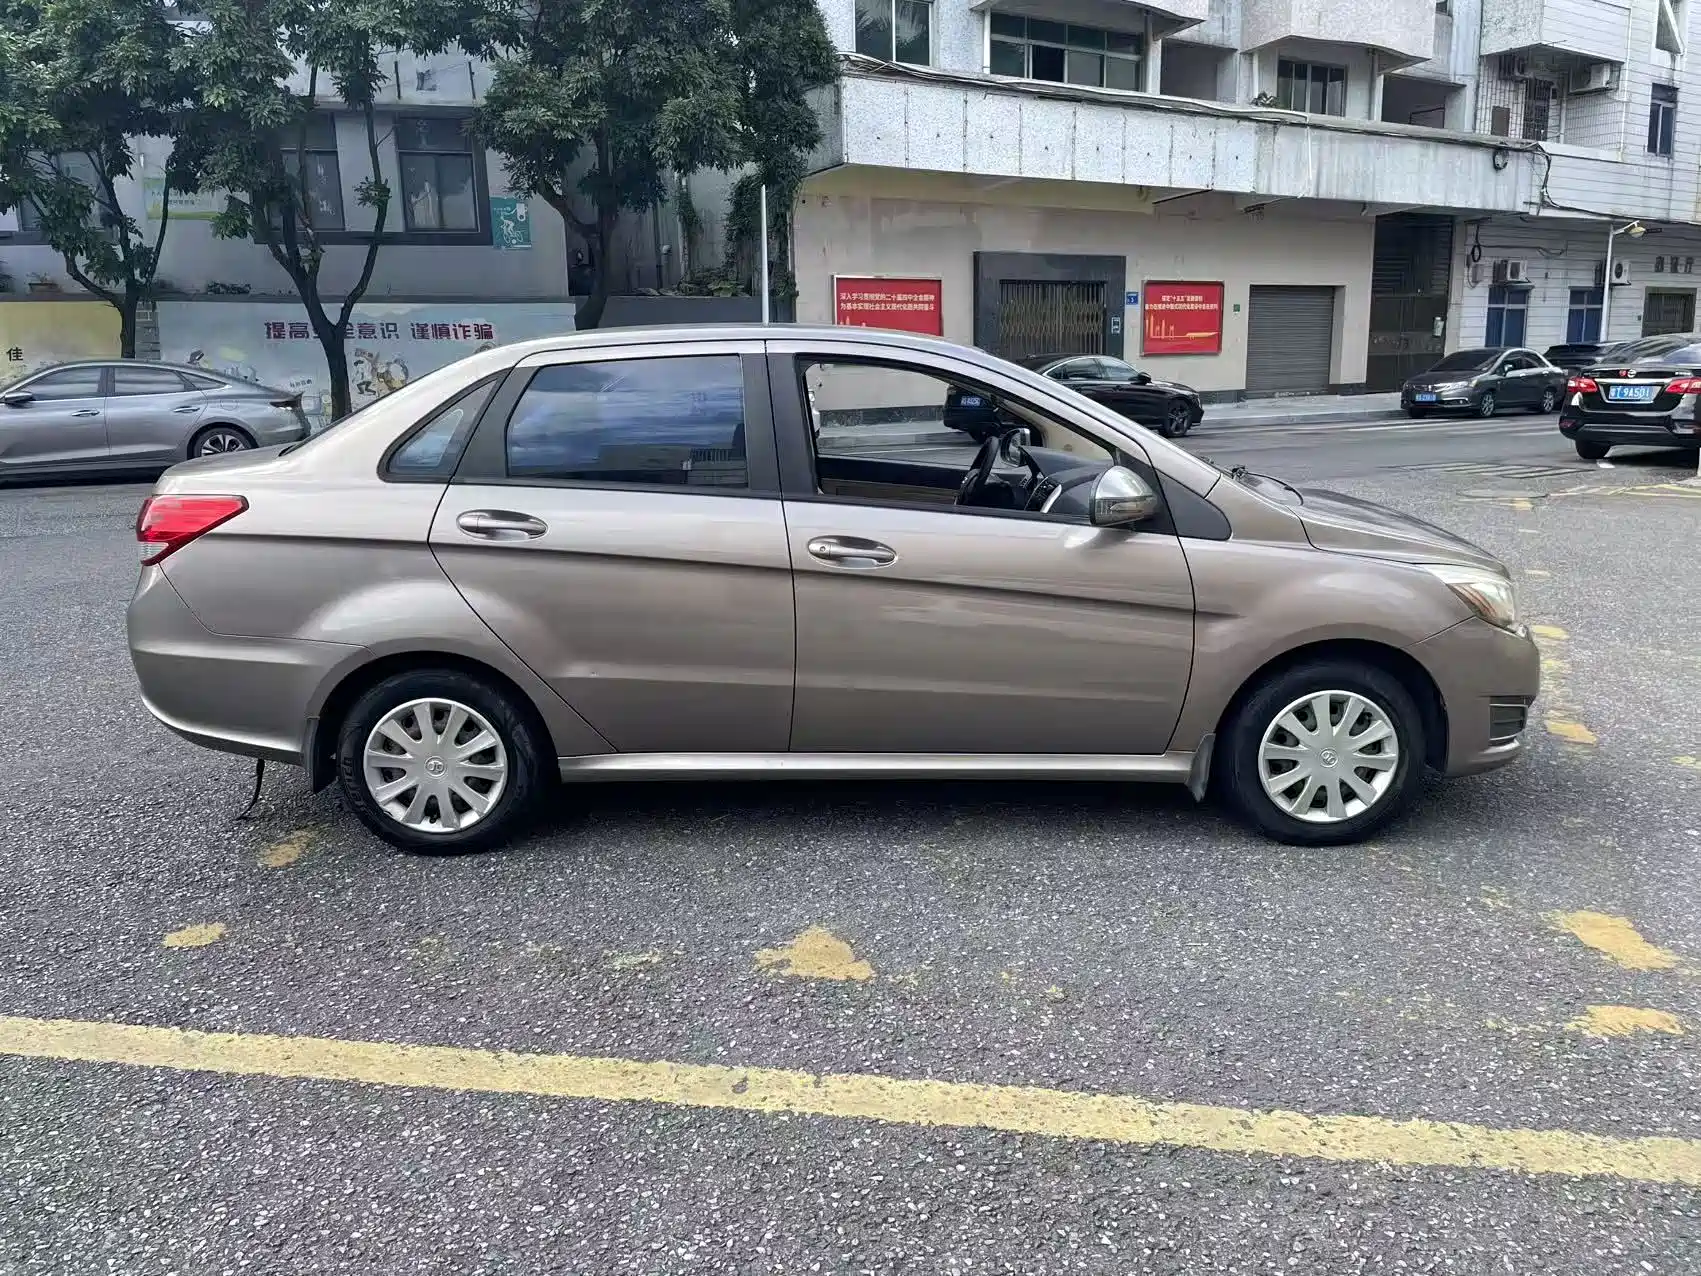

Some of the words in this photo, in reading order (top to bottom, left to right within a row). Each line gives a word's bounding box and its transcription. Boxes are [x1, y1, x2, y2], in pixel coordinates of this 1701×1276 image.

[265, 321, 400, 340] 提高全意识
[411, 322, 494, 341] 谨慎诈骗
[6, 346, 24, 363] 佳
